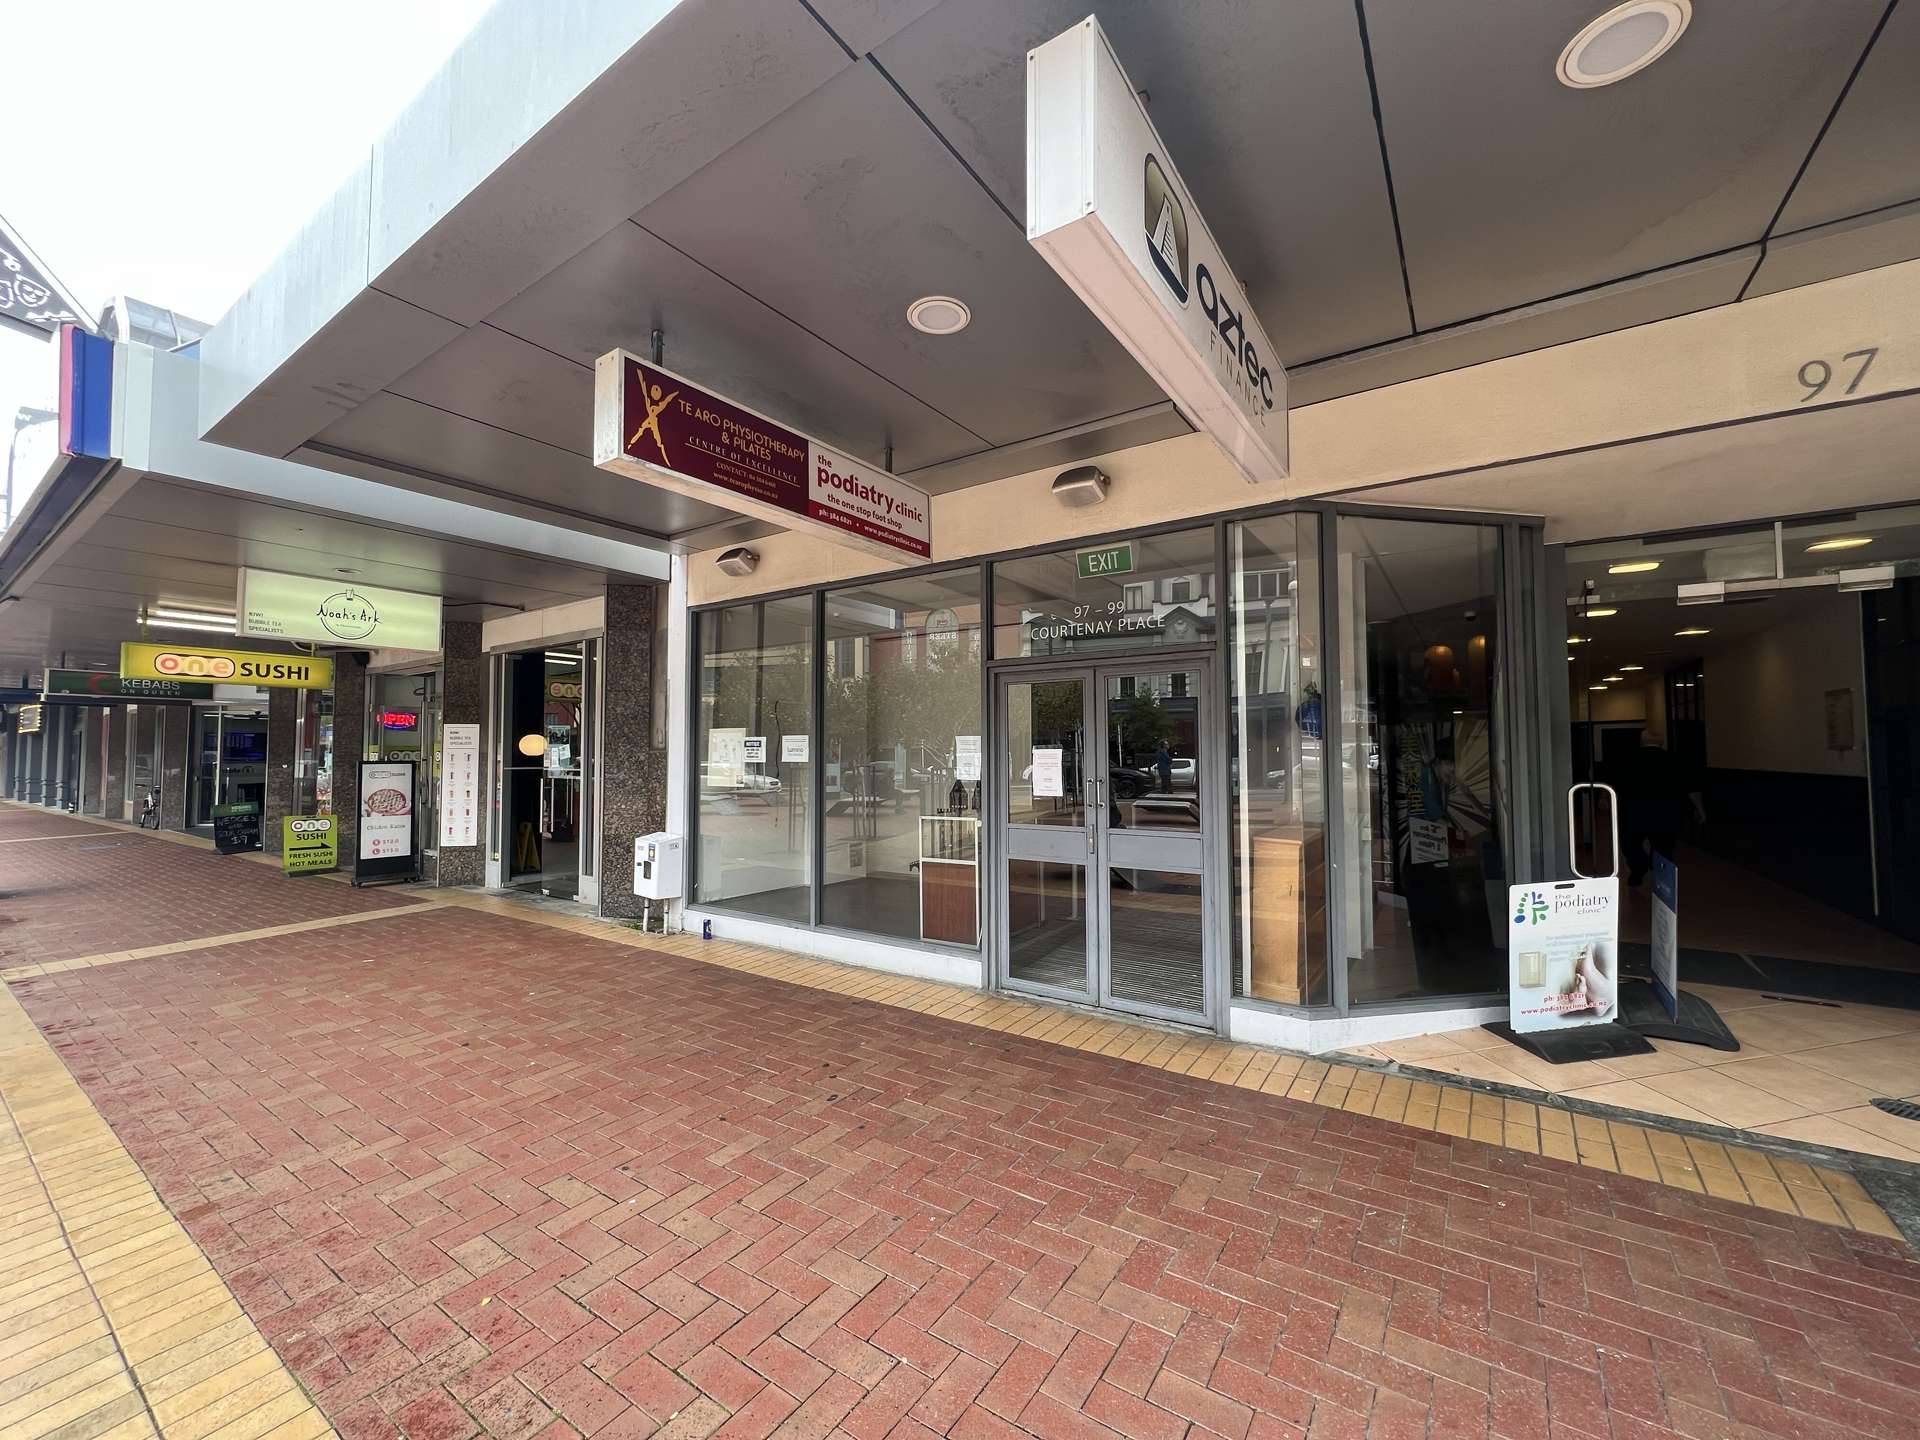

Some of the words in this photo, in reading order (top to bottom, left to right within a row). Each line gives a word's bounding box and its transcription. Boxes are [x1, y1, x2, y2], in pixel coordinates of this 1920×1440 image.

[1195, 263, 1273, 410] aztec
[1210, 329, 1266, 427] FINANCE
[1798, 347, 1879, 402] 97
[678, 400, 692, 415] TE
[695, 408, 720, 426] ARO
[723, 419, 806, 462] PHYSIOTHERAPY
[722, 432, 730, 445] &
[734, 437, 771, 460] PILATES
[689, 436, 726, 456] CENTRE
[731, 452, 741, 462] OF
[746, 458, 799, 482] EXCELLENCE
[818, 454, 832, 468] the
[817, 466, 894, 514] podiatry
[895, 502, 923, 523] clinic
[827, 493, 841, 505] the
[842, 500, 855, 511] one
[856, 504, 872, 519] stop
[872, 510, 887, 523] foot
[887, 517, 903, 530] shop
[1088, 551, 1120, 573] EXIT
[316, 604, 356, 622] Noah's
[360, 608, 383, 625] Ark
[1074, 605, 1090, 619] 97
[1107, 601, 1125, 615] 99
[248, 625, 284, 634] SPECIALISTS
[1031, 619, 1113, 640] COURTENAY
[1118, 615, 1166, 631] PLACE
[158, 656, 232, 675] one
[240, 662, 310, 681] SUSHI
[121, 679, 180, 690] KEBABS
[293, 820, 330, 831] one
[296, 833, 326, 841] SUSHI
[1555, 895, 1609, 913] podiatry
